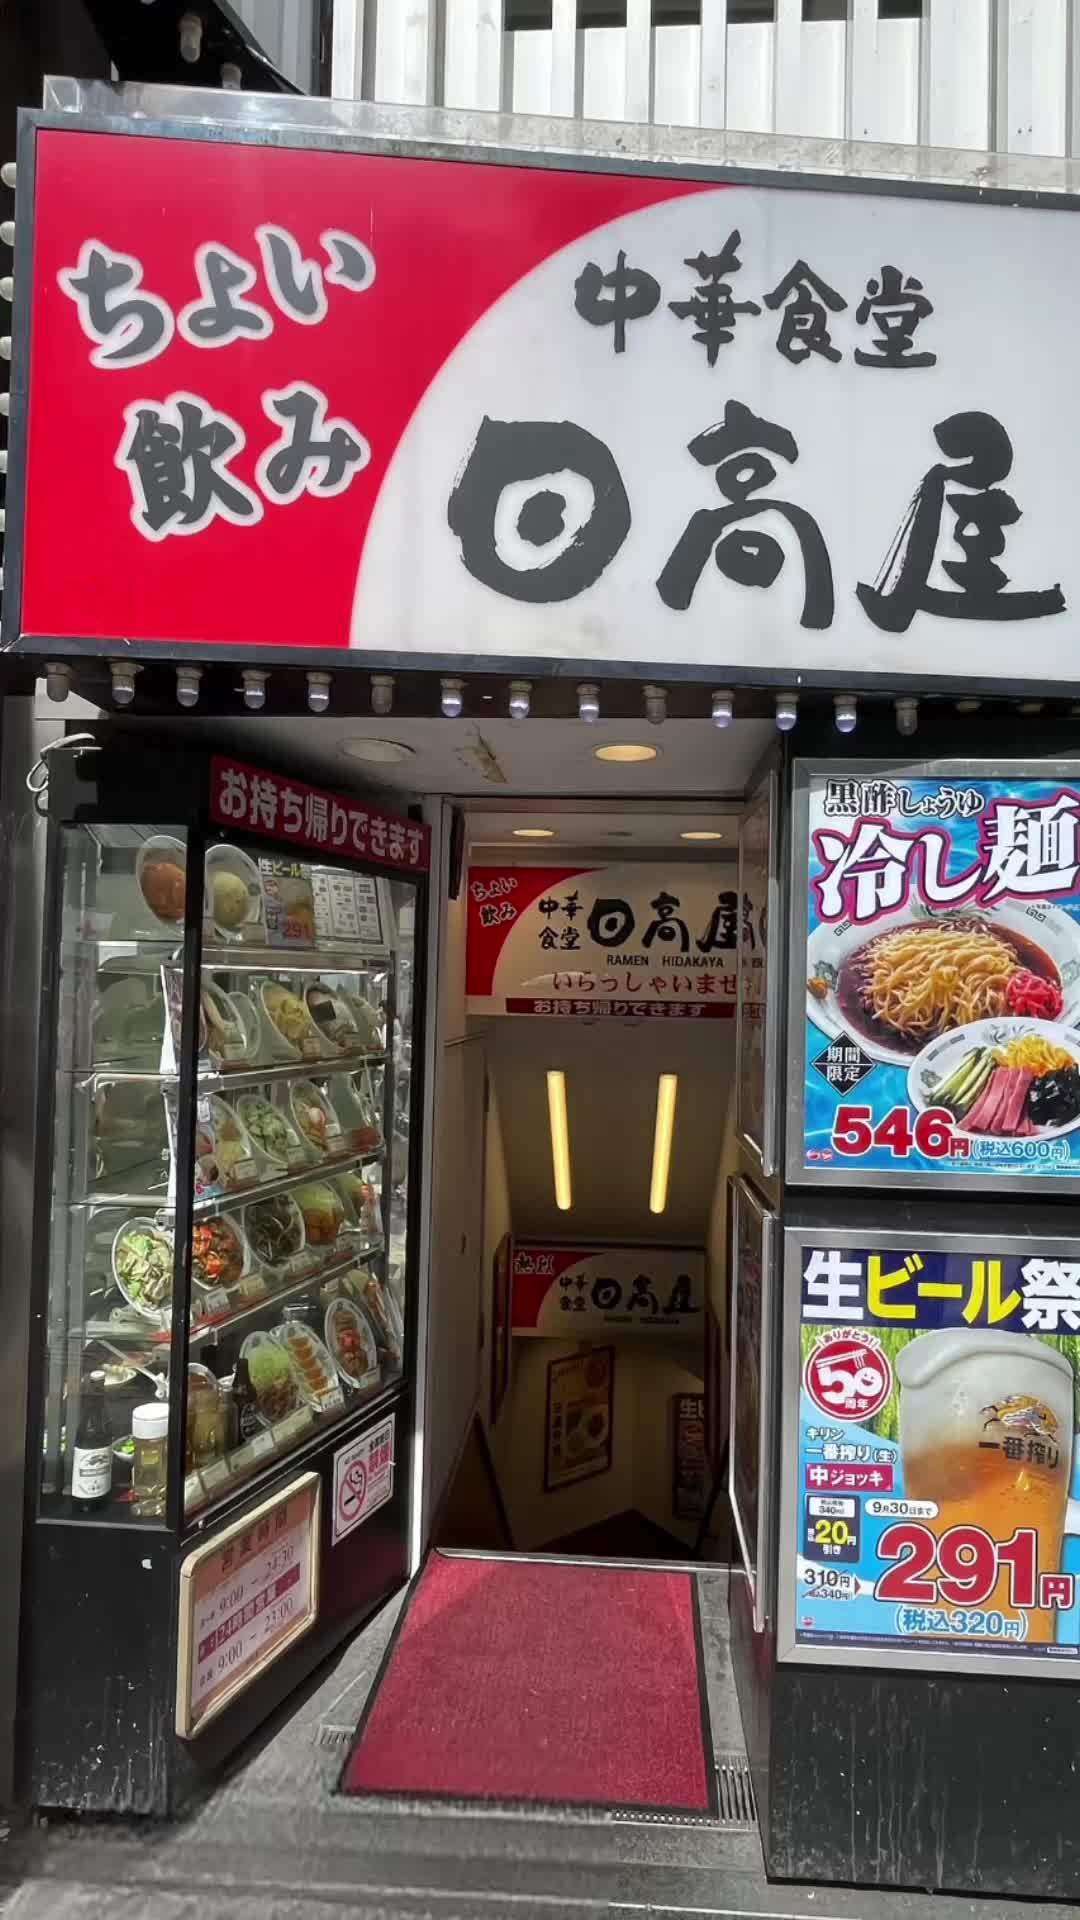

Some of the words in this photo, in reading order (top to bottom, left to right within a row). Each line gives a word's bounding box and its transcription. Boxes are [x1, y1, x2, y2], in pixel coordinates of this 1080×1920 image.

[58, 223, 375, 369] ちょい
[574, 231, 937, 366] 中華食堂
[117, 381, 371, 542] 飲み
[448, 400, 1067, 632] 日高屋
[825, 780, 984, 818] 黒酢しょうゆ
[219, 768, 424, 865] お持ち帰りできます
[814, 793, 1079, 921] 冷し麺
[479, 902, 518, 927] 飲み
[538, 890, 583, 920] 中華
[587, 891, 738, 952] 日高屋
[538, 926, 581, 950] 食堂
[607, 954, 649, 966] RAMEN
[662, 955, 724, 968] HIDAKAYA
[552, 971, 737, 995] いらっしゃいませ
[533, 1000, 706, 1017] お持ち帰りできます
[826, 1046, 861, 1064] 期間
[826, 1065, 861, 1082] 限定
[803, 1250, 1080, 1330] 生ビール祭
[806, 1425, 844, 1441] キリン
[978, 1436, 1059, 1469] 一番搾り
[809, 1465, 884, 1487] 中ジョッキ
[872, 1501, 933, 1516] 9月30日まで
[875, 1523, 1073, 1610] 291円
[895, 1608, 1028, 1640] (税込320円)
